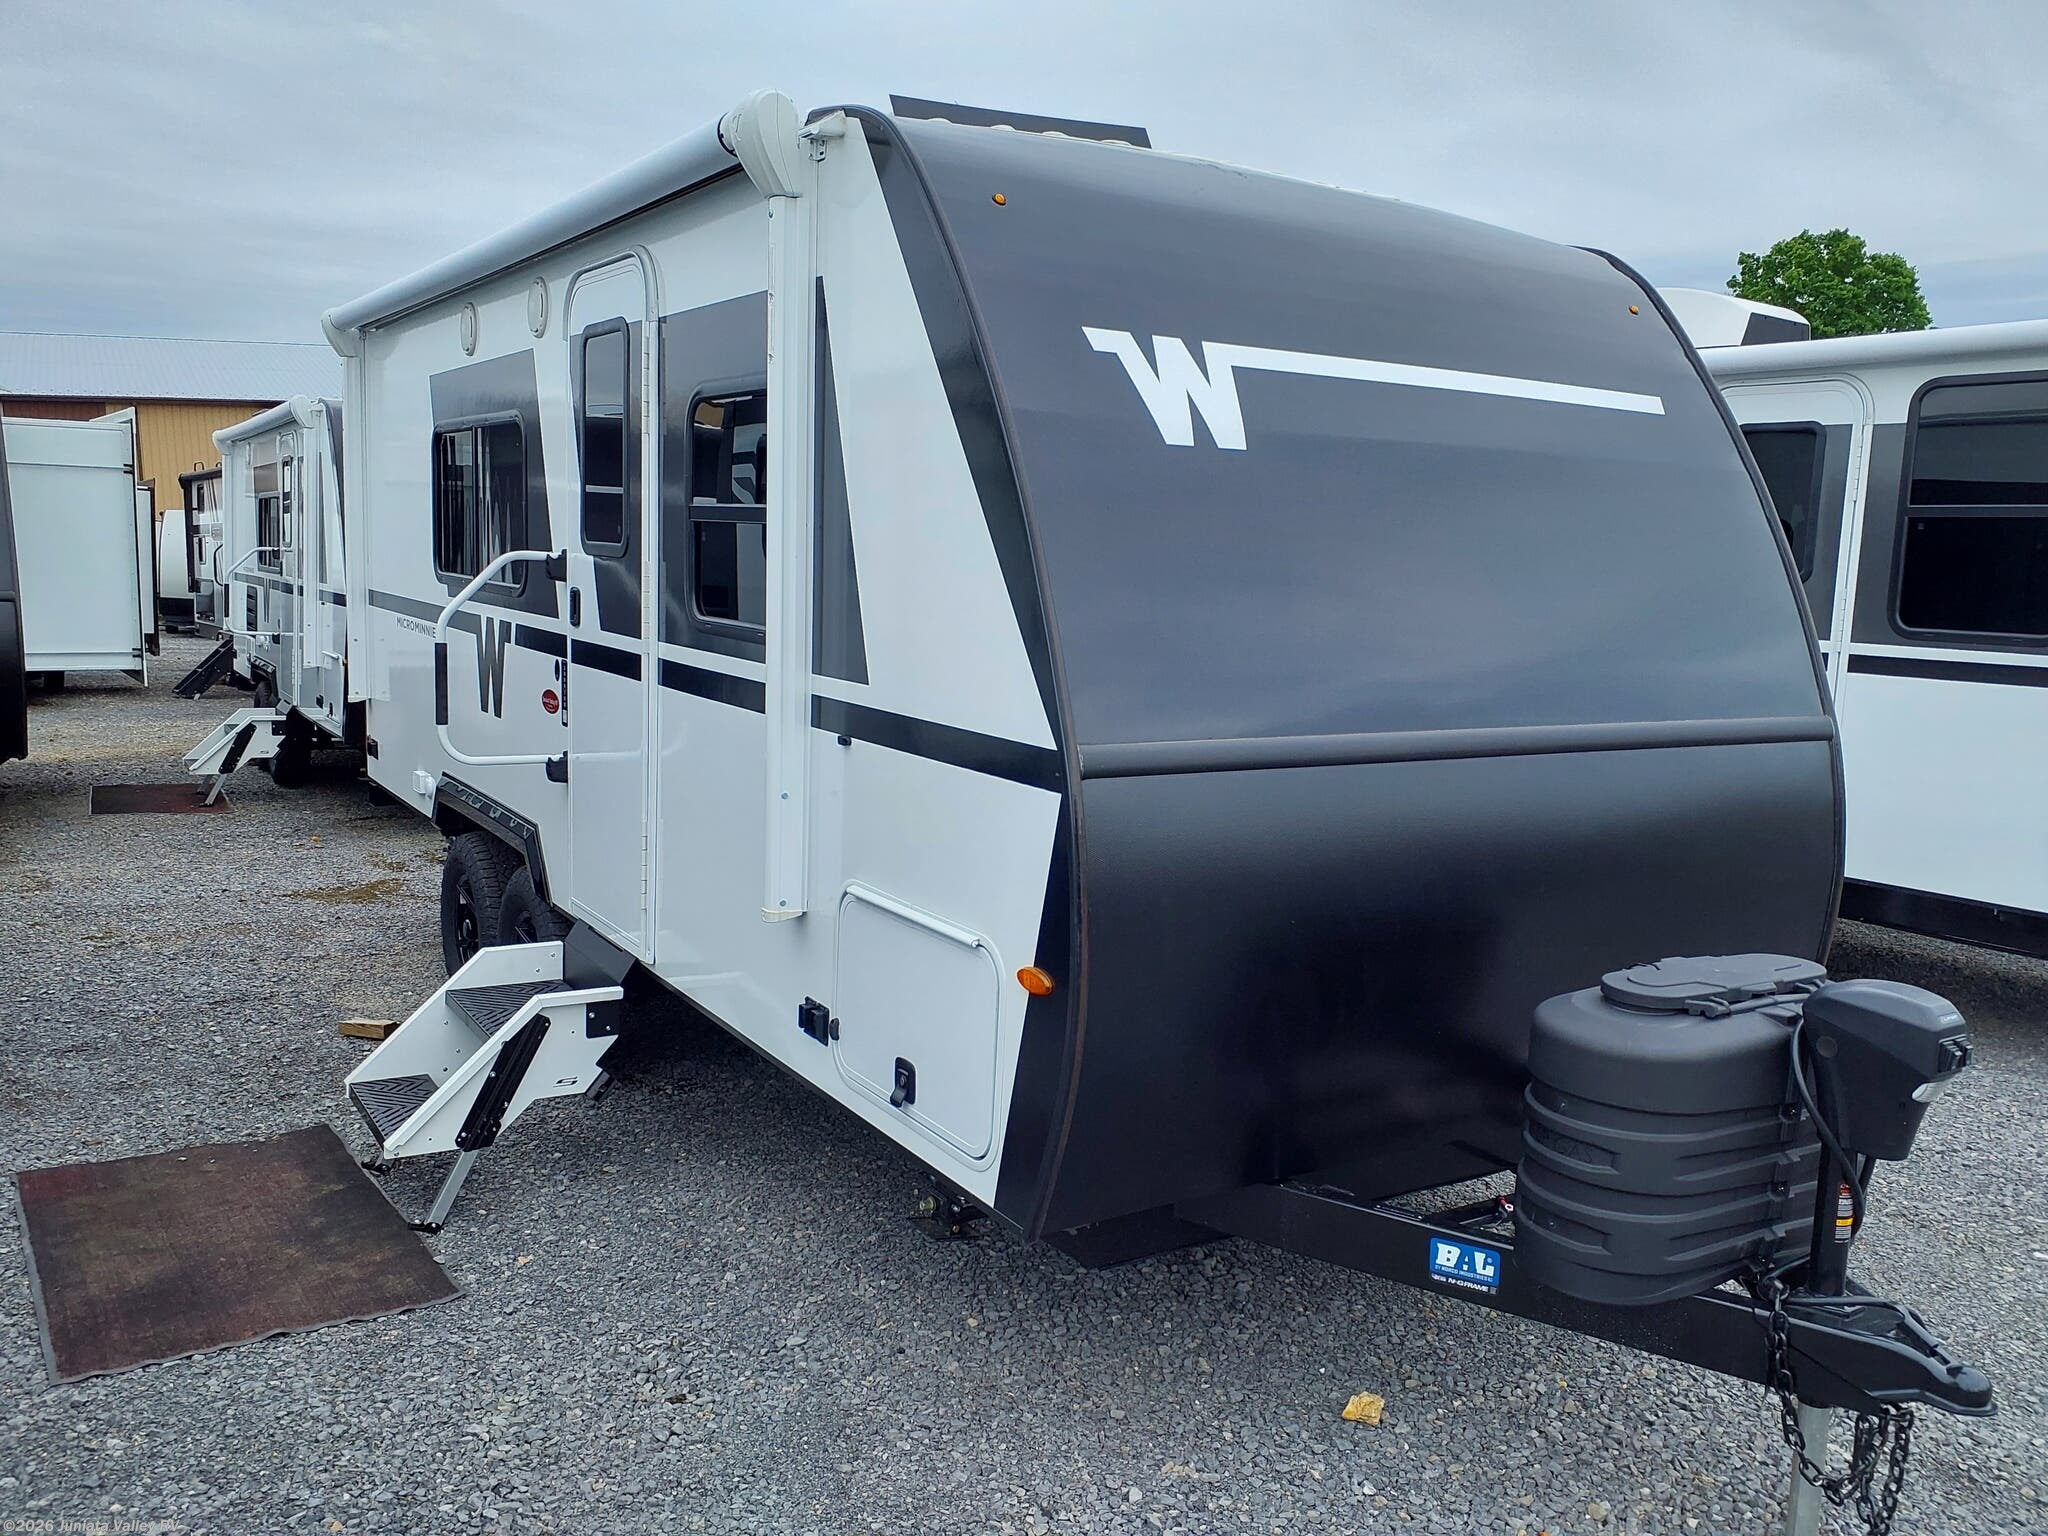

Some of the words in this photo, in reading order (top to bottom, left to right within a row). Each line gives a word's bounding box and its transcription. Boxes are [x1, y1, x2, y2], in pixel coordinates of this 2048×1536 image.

[1081, 326, 1247, 451] W
[396, 616, 437, 639] MICROMINNIE
[476, 616, 512, 719] W
